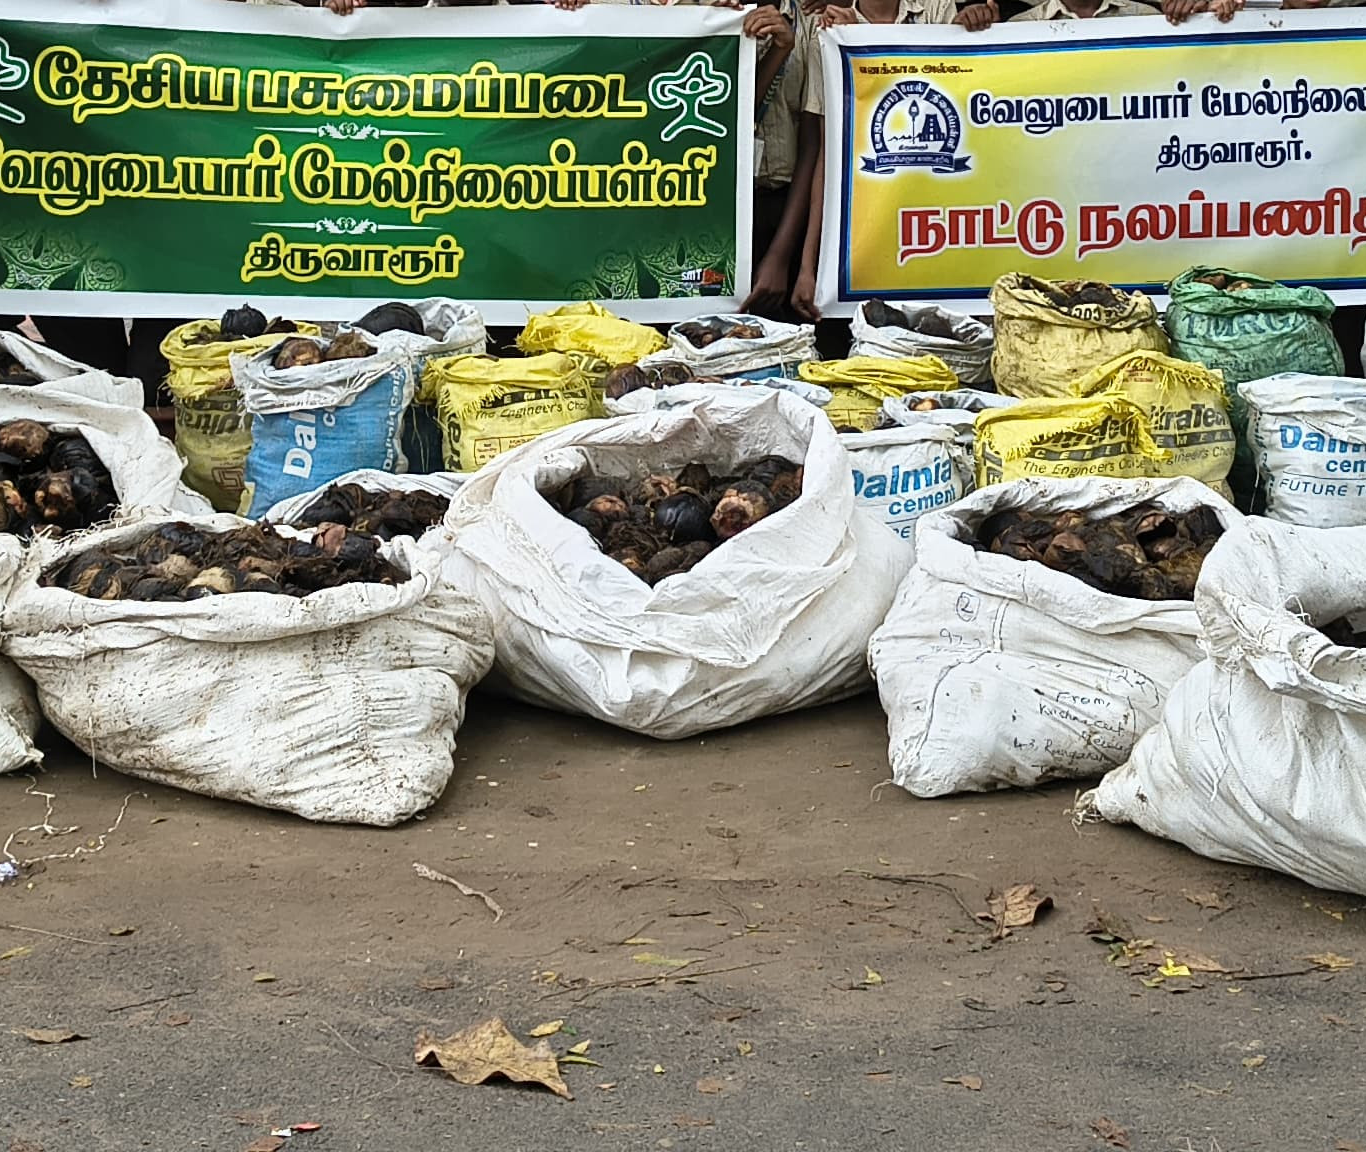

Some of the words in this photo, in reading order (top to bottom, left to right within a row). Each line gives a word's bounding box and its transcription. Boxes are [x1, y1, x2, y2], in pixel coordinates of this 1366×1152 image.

[35, 46, 239, 122] தேசிய
[248, 62, 647, 118] பசுமைப்படை
[969, 80, 1192, 134] வேலுடையார்
[292, 137, 716, 222] மேல்நிலைப்பள்ளி
[242, 232, 463, 283] திருவாரூர்
[898, 199, 1066, 263] நாட்டு
[282, 411, 317, 480] Dal
[1023, 460, 1047, 474] The
[888, 485, 957, 516] cement
[1279, 478, 1348, 497] FUTURE
